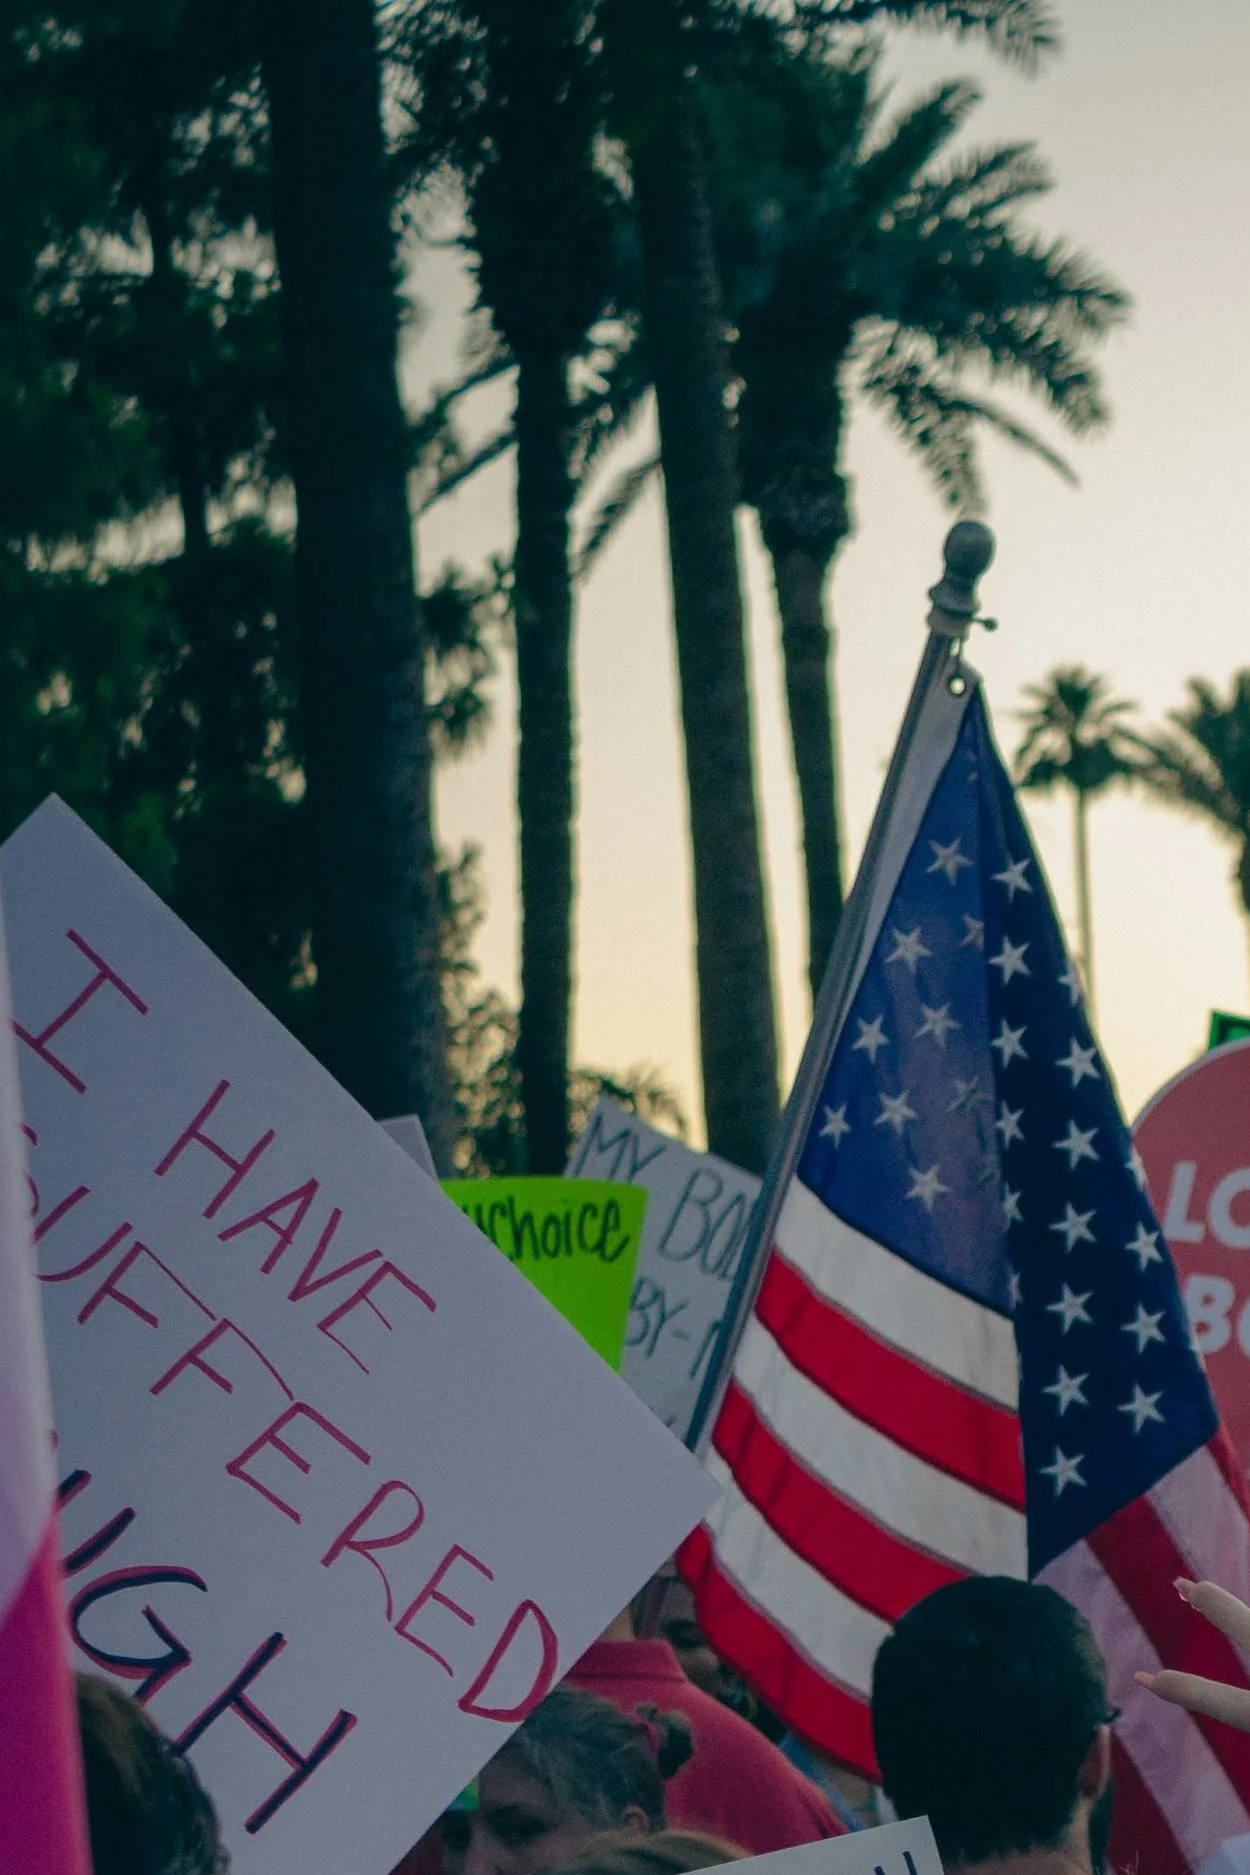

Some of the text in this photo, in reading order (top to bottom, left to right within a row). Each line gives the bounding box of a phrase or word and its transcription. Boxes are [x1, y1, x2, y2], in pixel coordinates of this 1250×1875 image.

[10, 928, 437, 1375] I HAVE
[573, 1112, 667, 1185] MY
[52, 1466, 358, 1835] UGH
